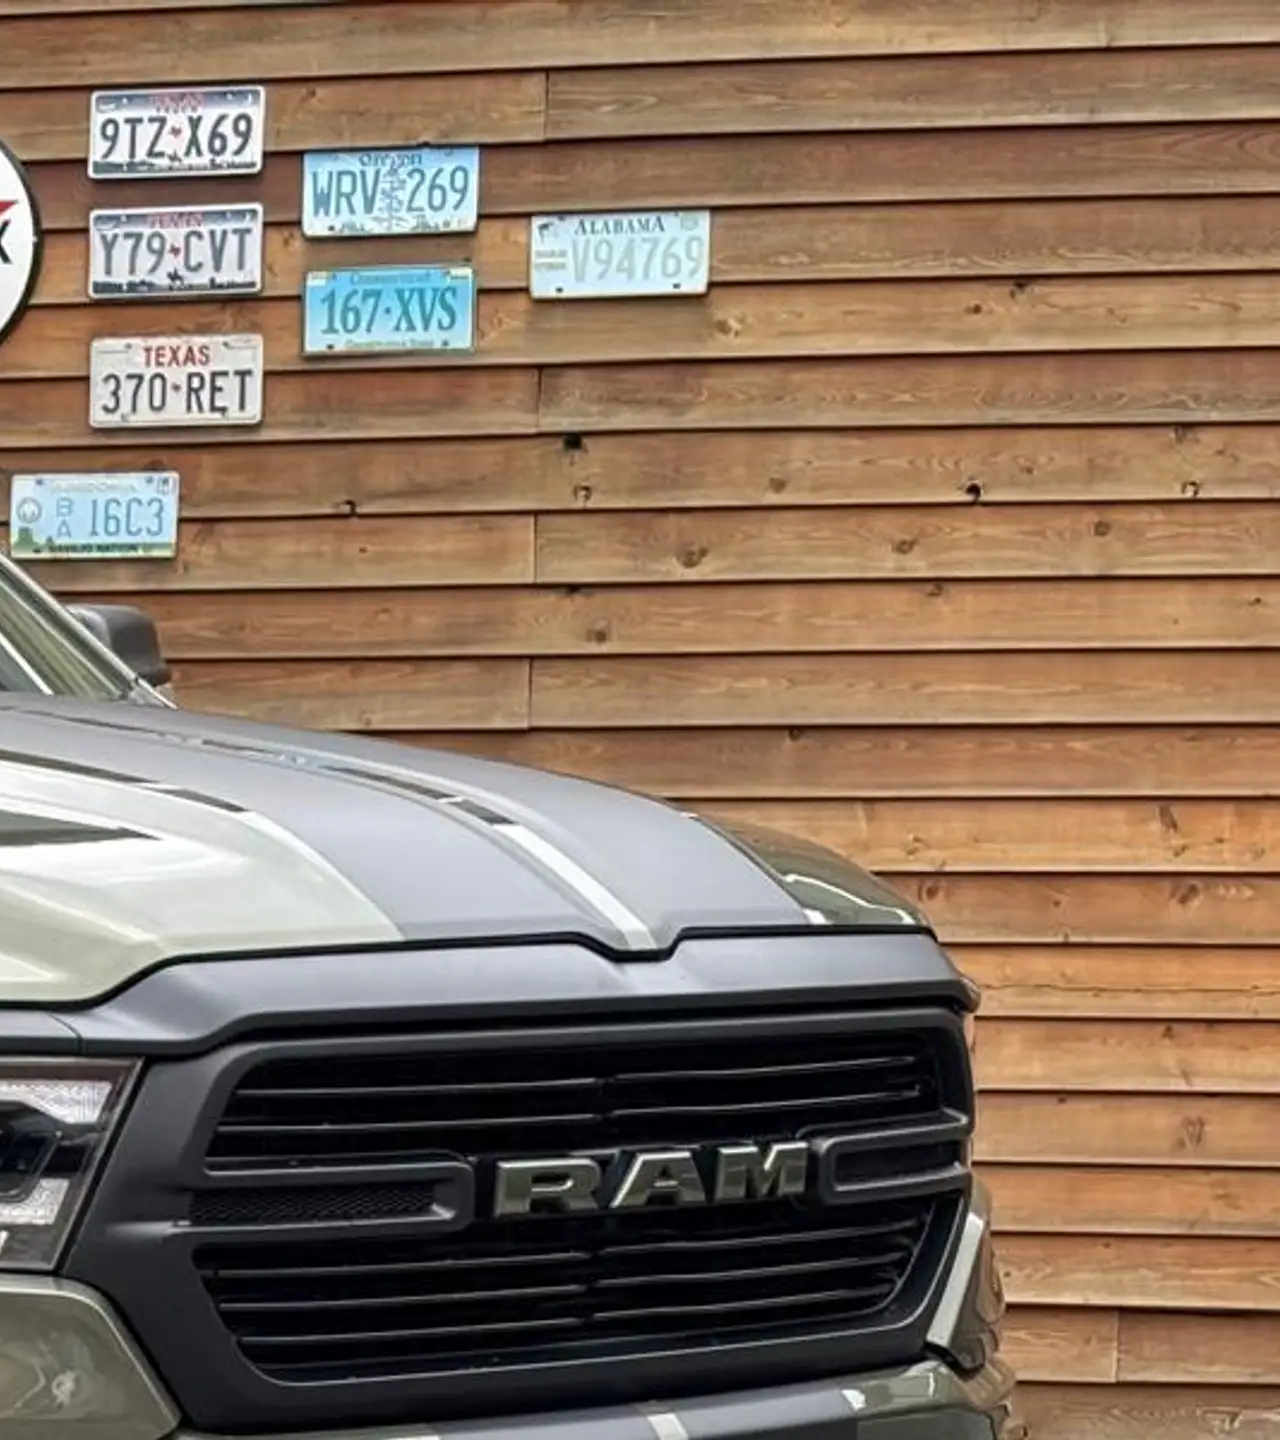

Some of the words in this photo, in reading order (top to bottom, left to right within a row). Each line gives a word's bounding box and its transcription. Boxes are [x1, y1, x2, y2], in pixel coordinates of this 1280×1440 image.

[100, 114, 168, 160] 9TZ
[184, 111, 253, 158] X69
[311, 168, 382, 217] WRV
[405, 165, 470, 213] 269
[574, 215, 666, 236] ALABAMA
[99, 230, 167, 276] Y79
[183, 227, 253, 273] CVT
[143, 344, 212, 368] TEXAS
[101, 371, 168, 415] 370
[185, 368, 254, 414] RET
[89, 497, 165, 538] 16C3
[494, 1140, 809, 1217] RAM
